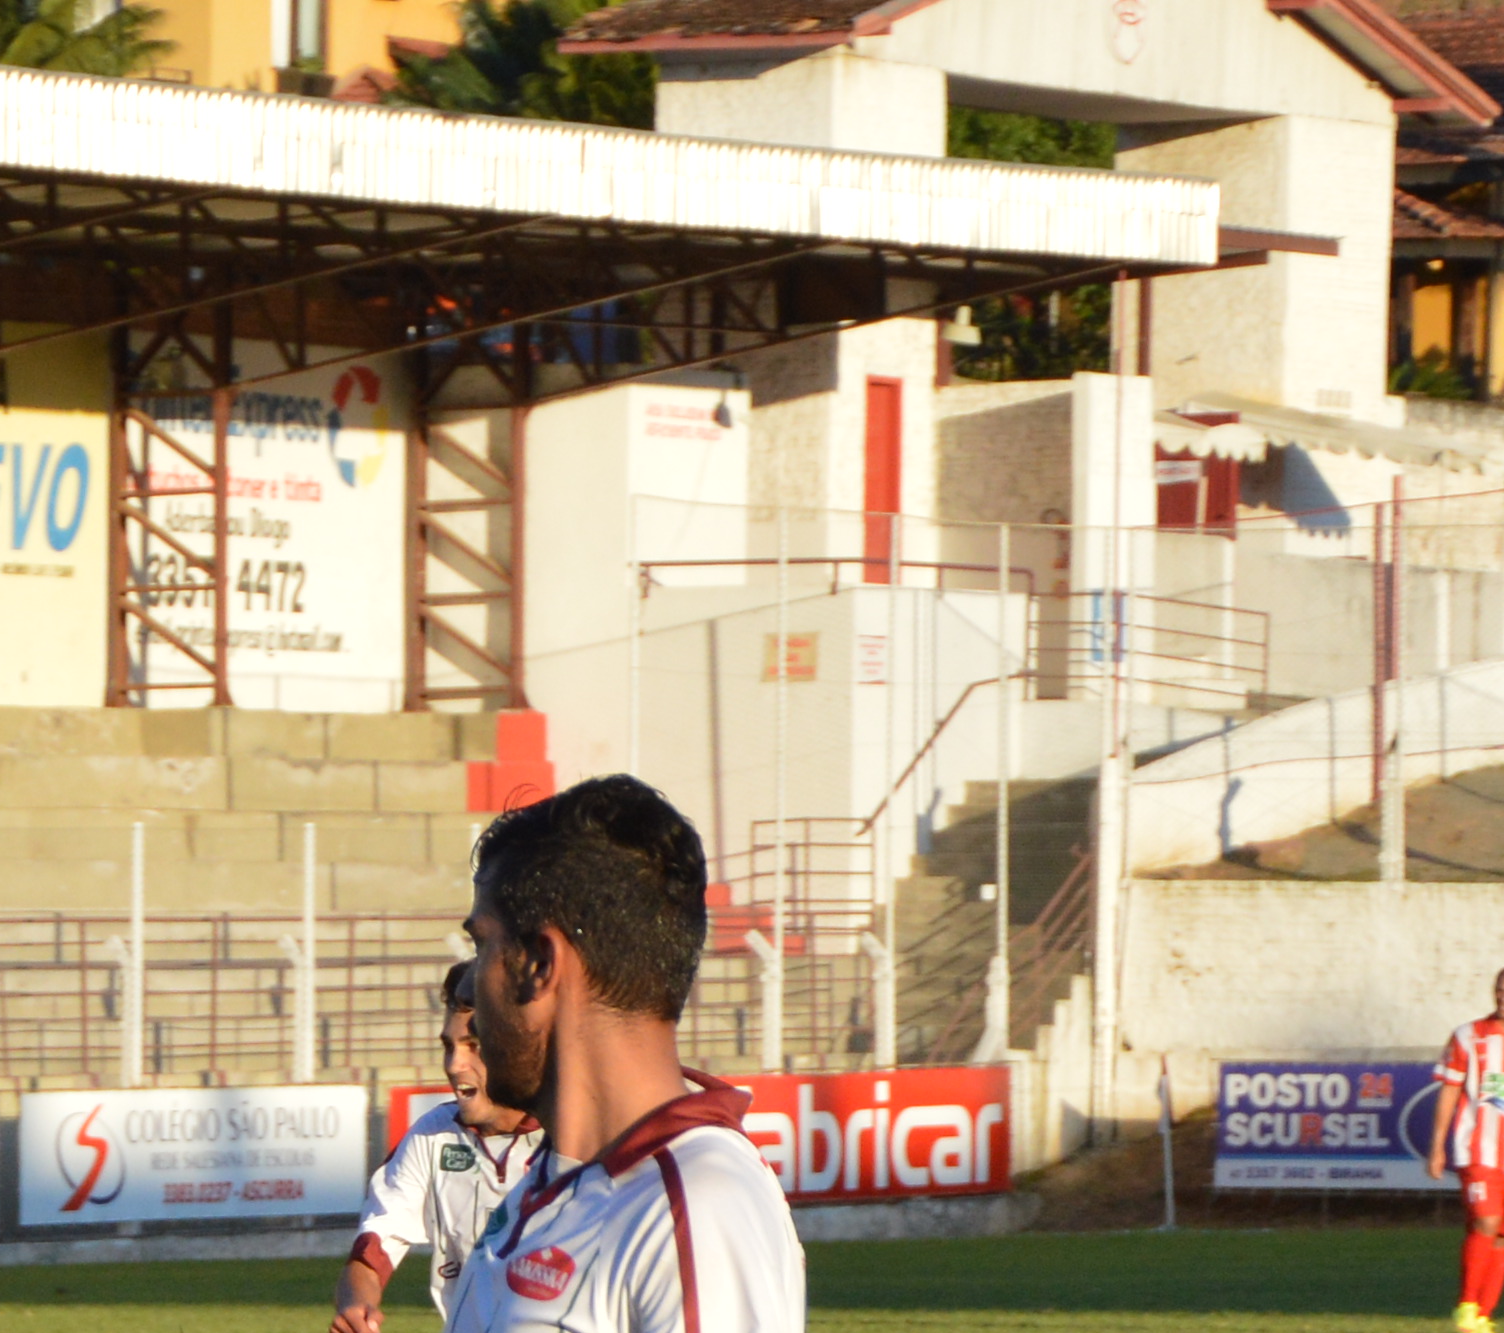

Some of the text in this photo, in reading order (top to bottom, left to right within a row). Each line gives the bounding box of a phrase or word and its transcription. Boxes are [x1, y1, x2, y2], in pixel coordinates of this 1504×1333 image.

[1225, 1073, 1350, 1108] POSTO
[746, 1080, 1004, 1193] abricar
[1224, 1112, 1391, 1148] SCURSEL
